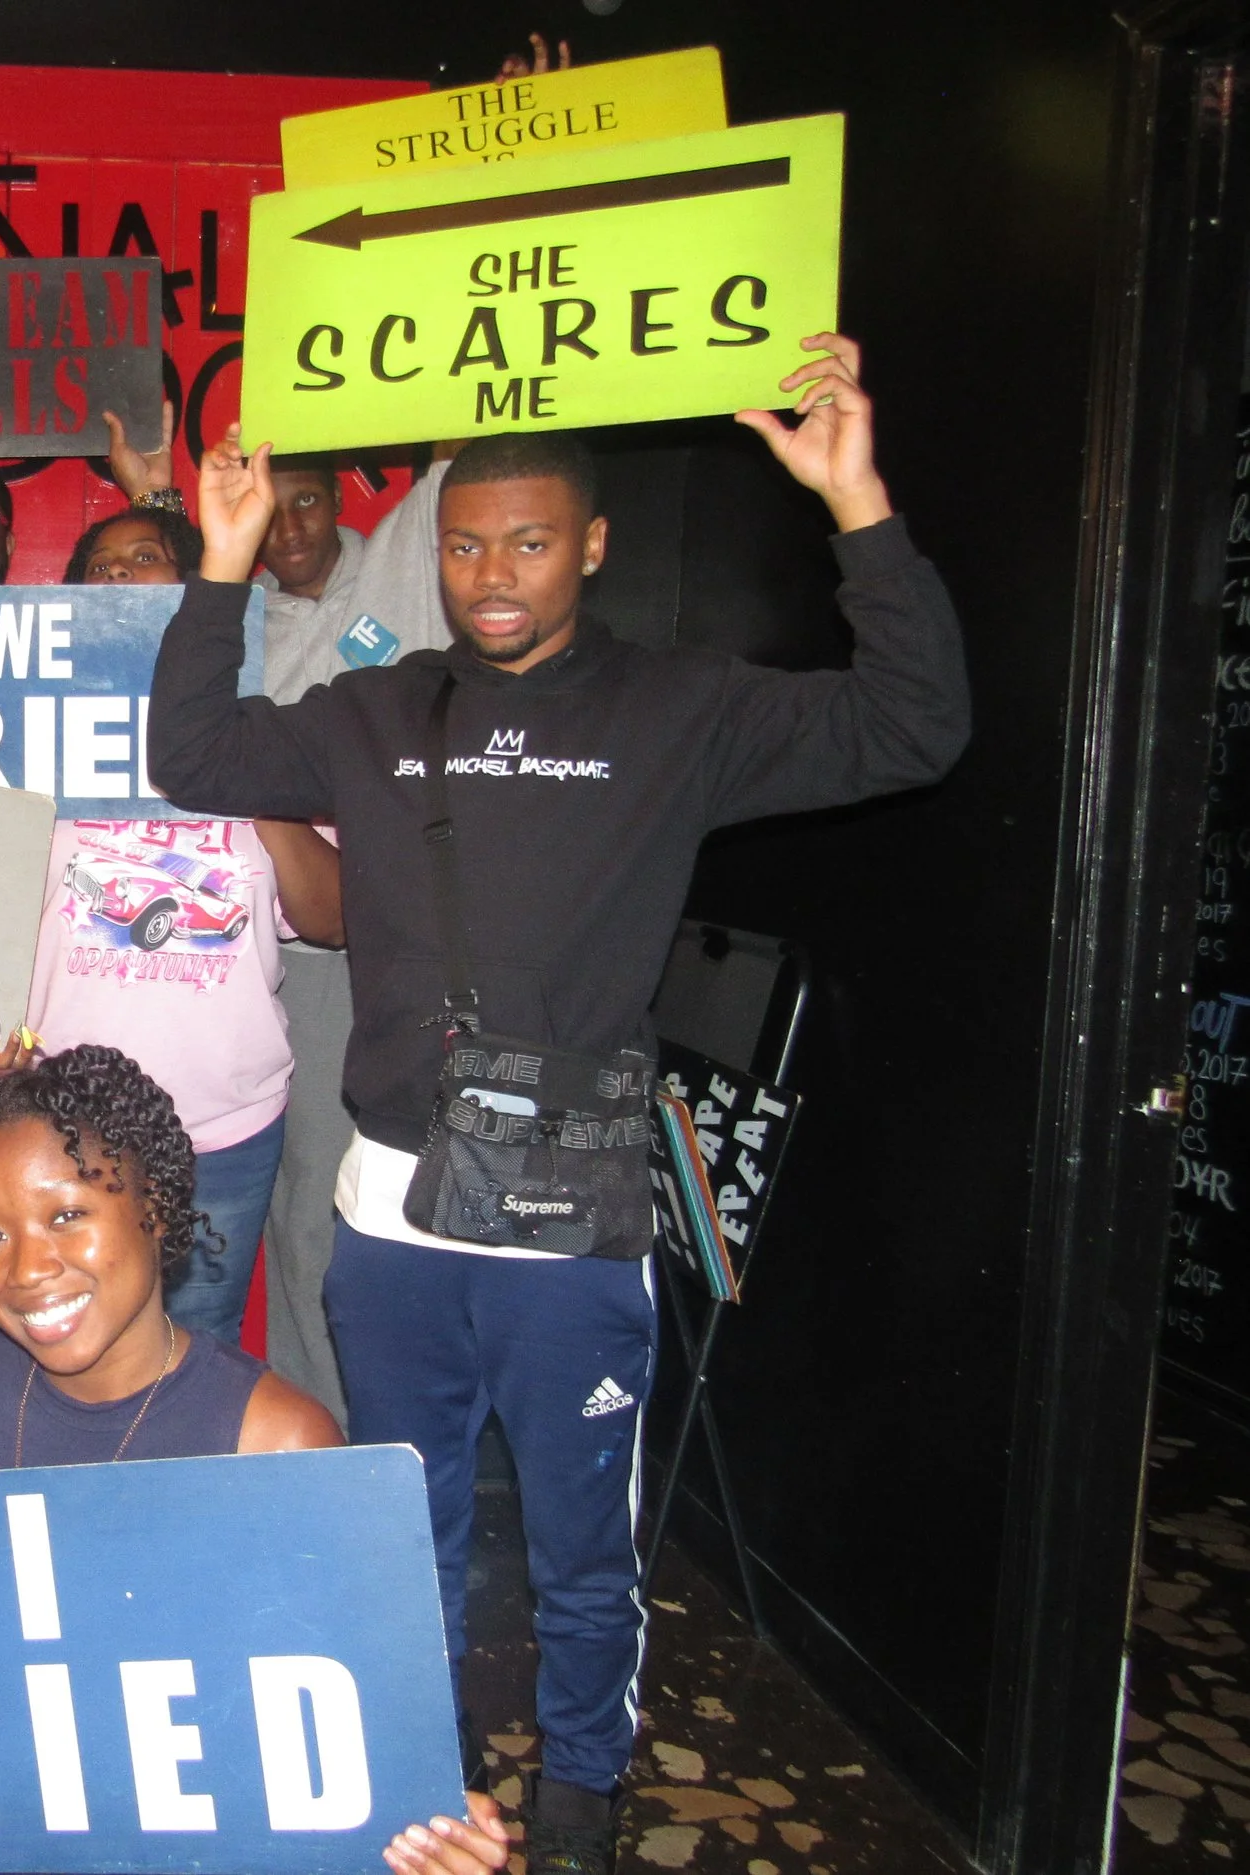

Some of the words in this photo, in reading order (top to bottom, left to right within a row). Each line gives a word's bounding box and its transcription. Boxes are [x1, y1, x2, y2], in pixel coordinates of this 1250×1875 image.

[447, 82, 537, 122] THE
[375, 101, 619, 168] STRUGGLE
[467, 244, 578, 297] SHE
[292, 274, 771, 391] SCARES
[474, 376, 558, 424] ME
[445, 757, 513, 776] MICHEL
[66, 946, 238, 983] OPPORTUNITY
[446, 1098, 648, 1149] SUPEME
[715, 1087, 788, 1247] EPEAT
[501, 1194, 574, 1217] Supreme
[581, 1393, 634, 1417] adidas
[5, 1493, 62, 1641] I
